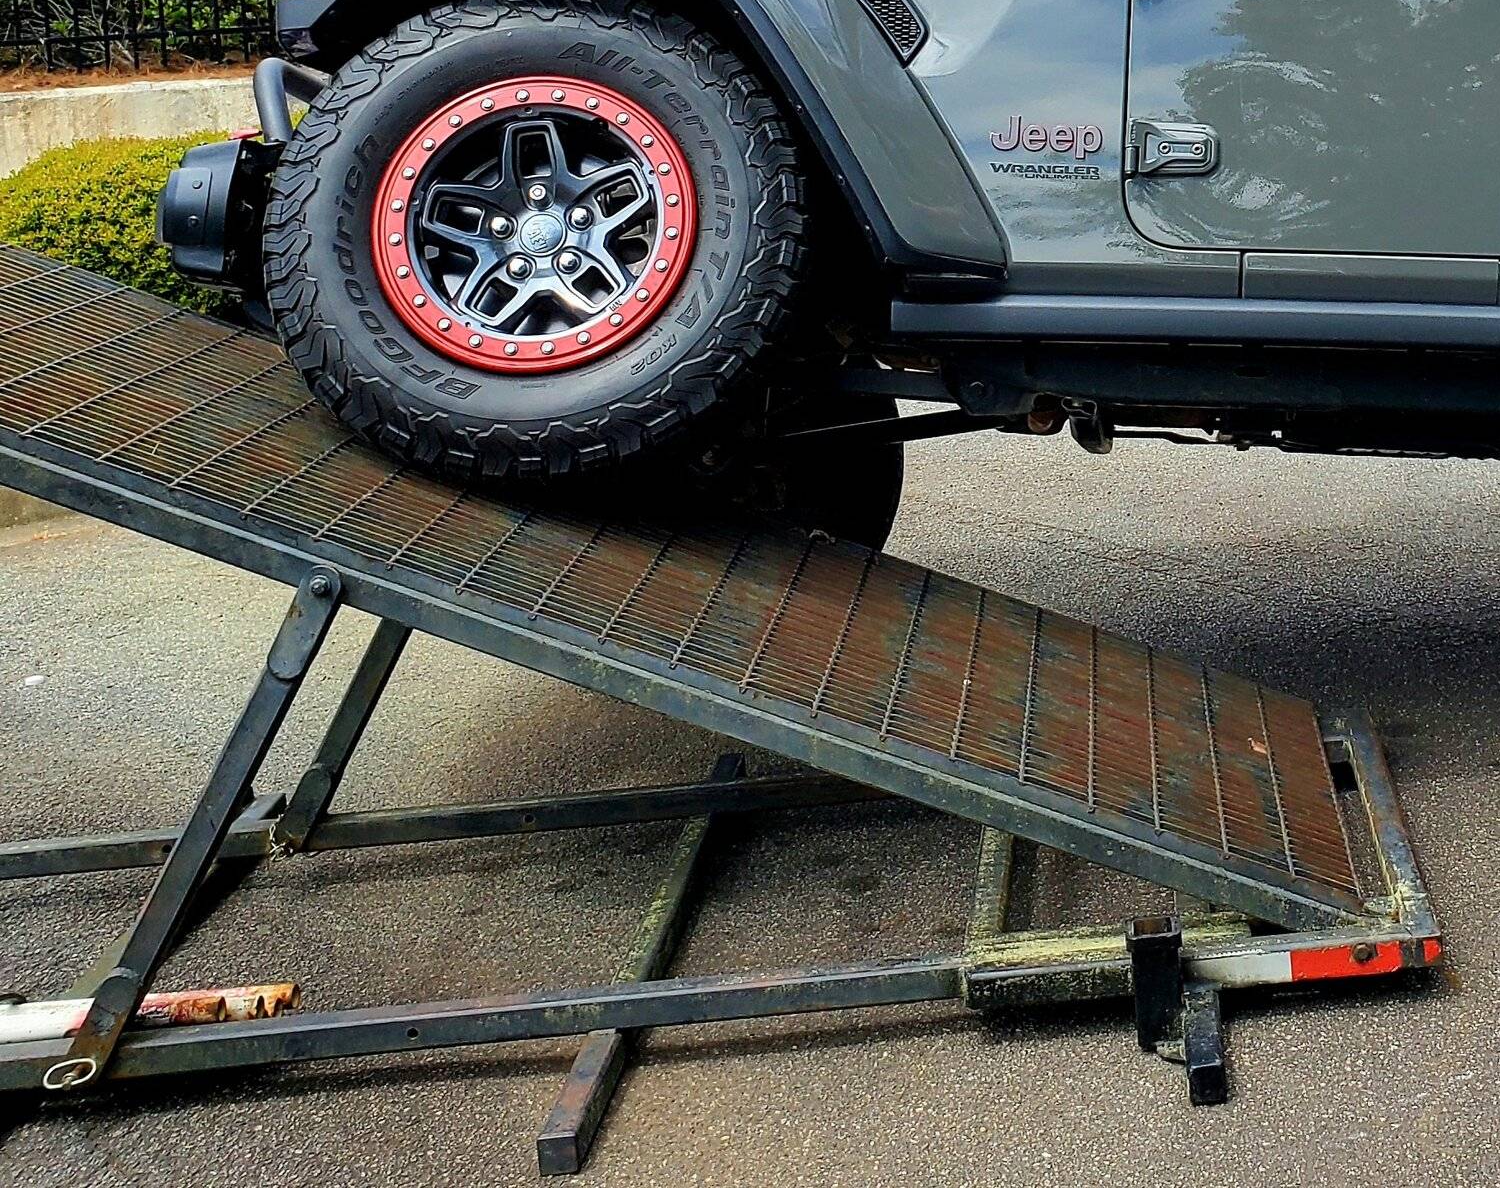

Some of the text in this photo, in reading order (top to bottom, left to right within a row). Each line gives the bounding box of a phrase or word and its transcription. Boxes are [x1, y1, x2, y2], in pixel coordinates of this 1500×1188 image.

[989, 115, 1103, 160] Jeep
[990, 162, 1100, 175] WRANGLER
[332, 133, 482, 400] BFGoodrich
